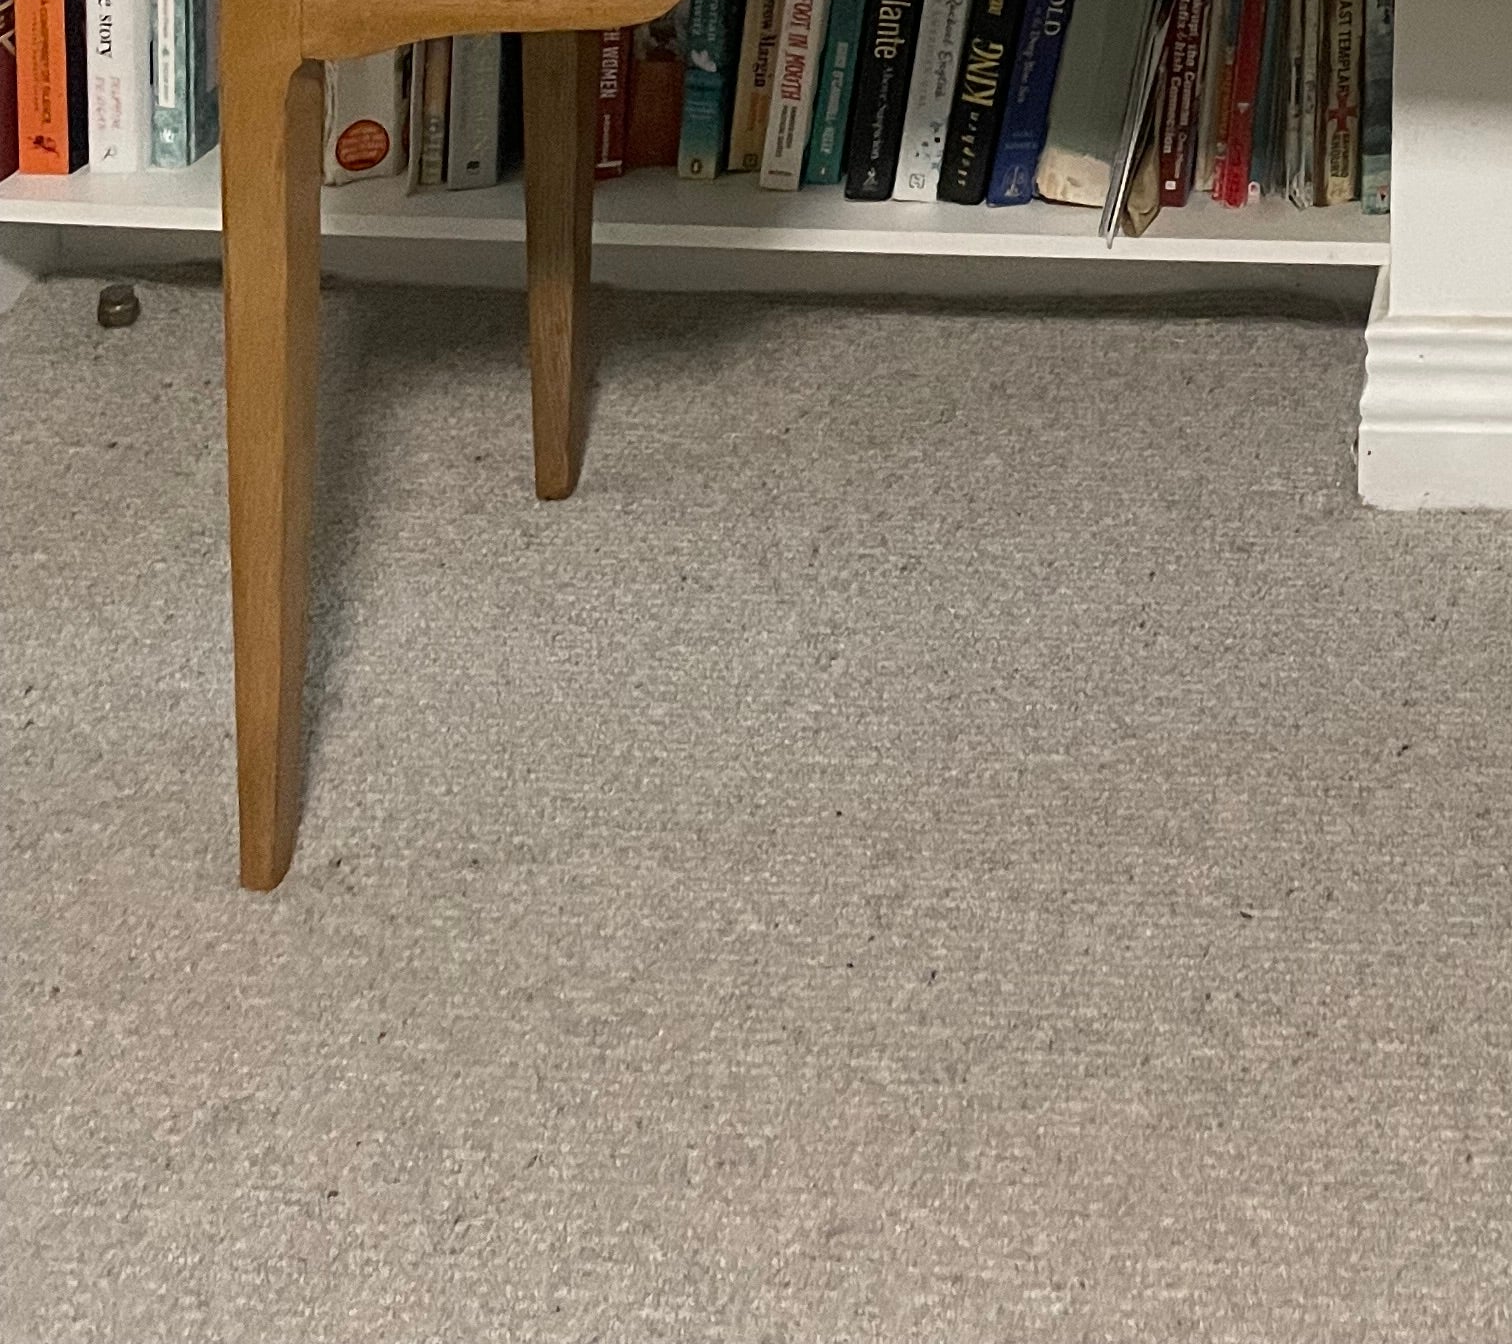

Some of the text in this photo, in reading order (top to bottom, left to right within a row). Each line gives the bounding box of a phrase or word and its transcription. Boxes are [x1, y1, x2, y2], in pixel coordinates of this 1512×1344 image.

[96, 14, 113, 58] story
[786, 32, 809, 48] IN
[782, 50, 806, 100] MOUTH
